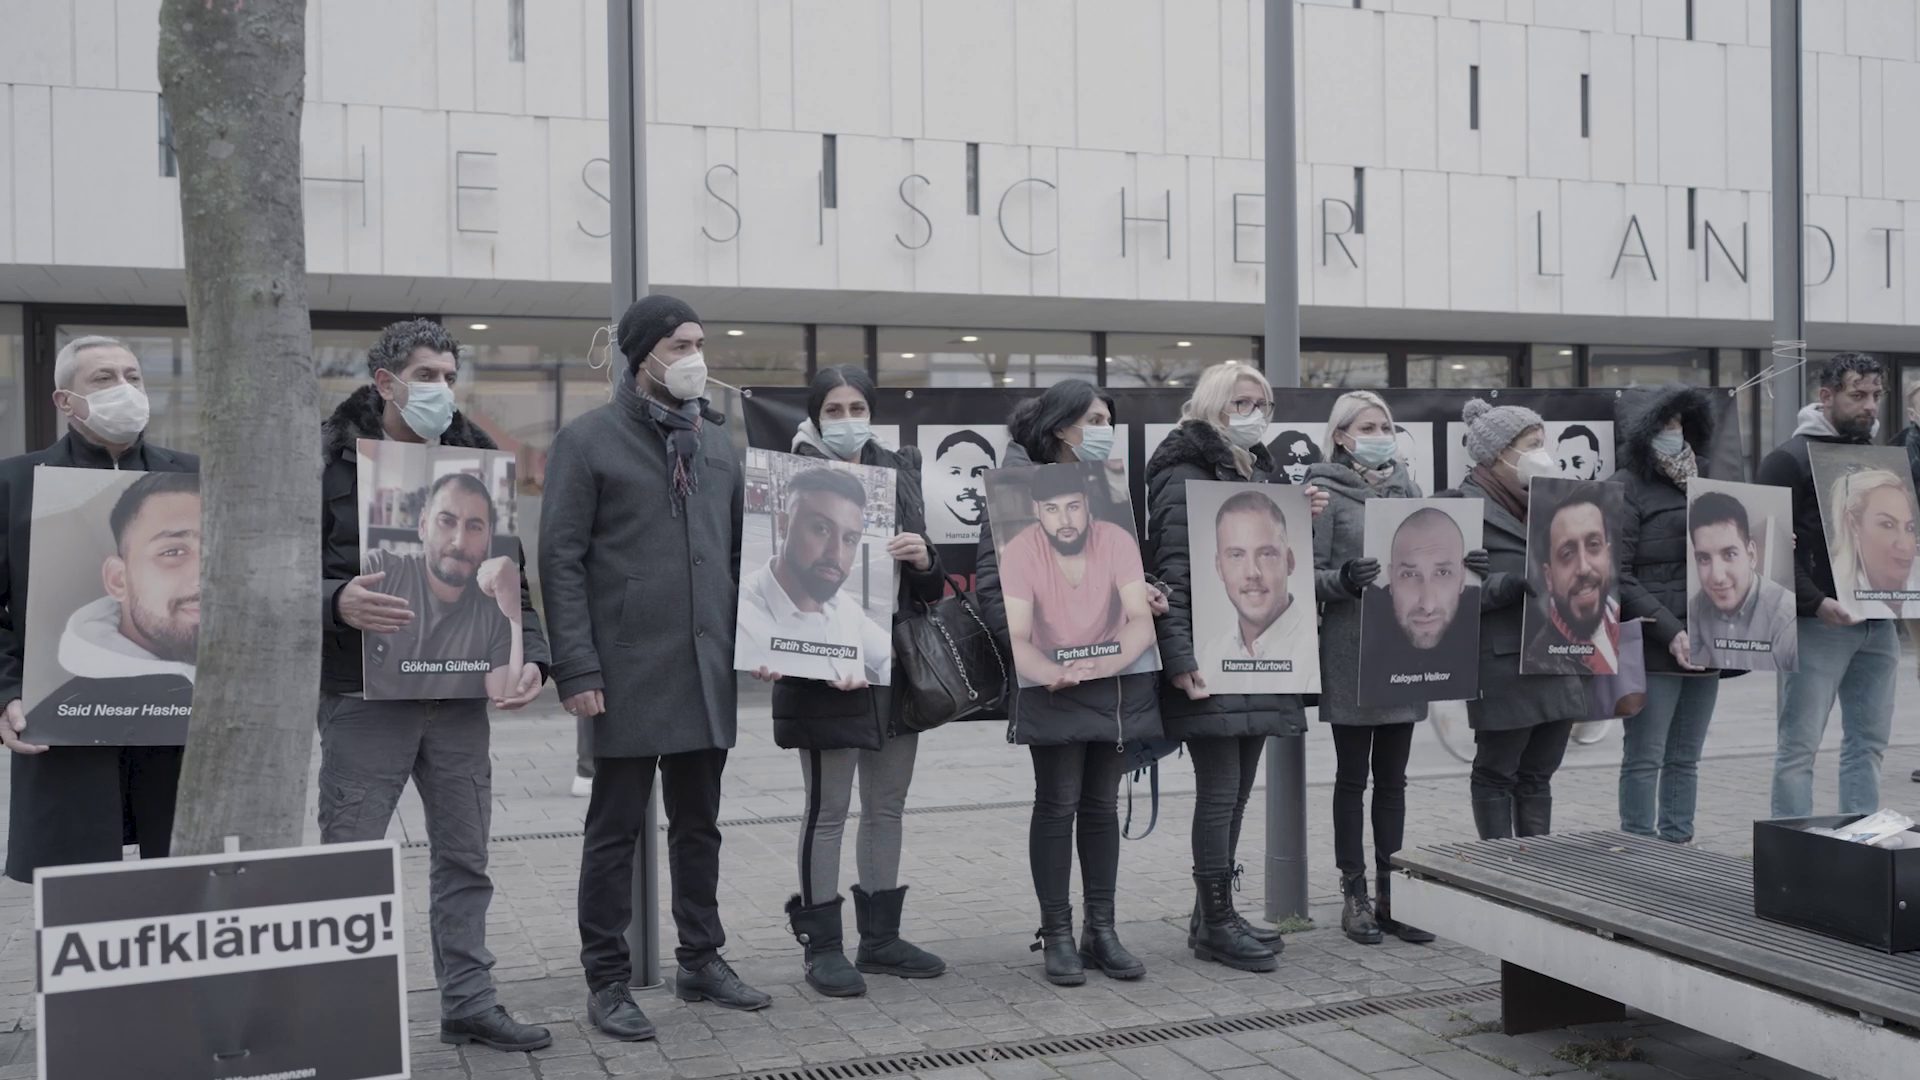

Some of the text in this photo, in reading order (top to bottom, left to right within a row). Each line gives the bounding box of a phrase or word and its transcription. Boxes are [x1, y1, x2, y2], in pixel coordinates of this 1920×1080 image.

[1855, 591, 1892, 600] Mercedes
[773, 638, 856, 659] Fatih Saraçoğlu
[1056, 643, 1119, 660] Ferhat Unvar
[1548, 644, 1569, 654] Sedat
[401, 660, 490, 673] Gökhan Gültekin
[1223, 660, 1291, 671] Hamza Kurtović
[1389, 671, 1451, 684] Kaloyan Velkov
[57, 703, 92, 717] Said
[94, 703, 139, 717] Nesar
[51, 901, 394, 977] Aufklärung!
